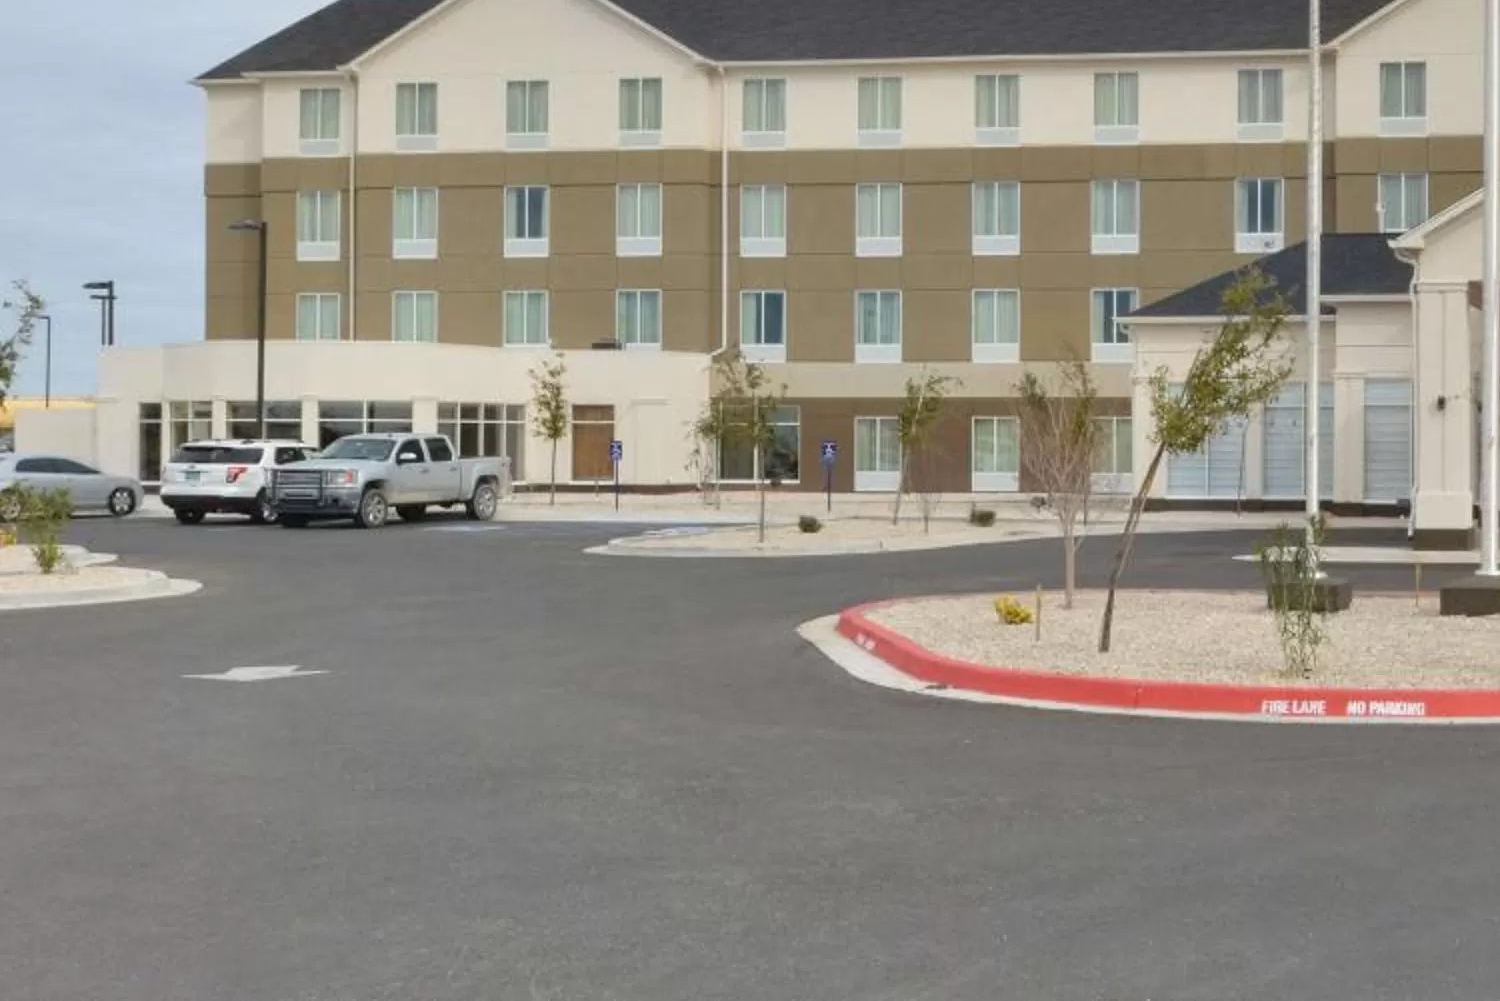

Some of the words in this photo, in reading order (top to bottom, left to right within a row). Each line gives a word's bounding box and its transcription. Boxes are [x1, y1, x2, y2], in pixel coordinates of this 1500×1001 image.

[1261, 699, 1289, 715] FIRE
[1292, 700, 1327, 716] LANE
[1346, 700, 1367, 716] NO
[1369, 701, 1425, 716] PARKING
